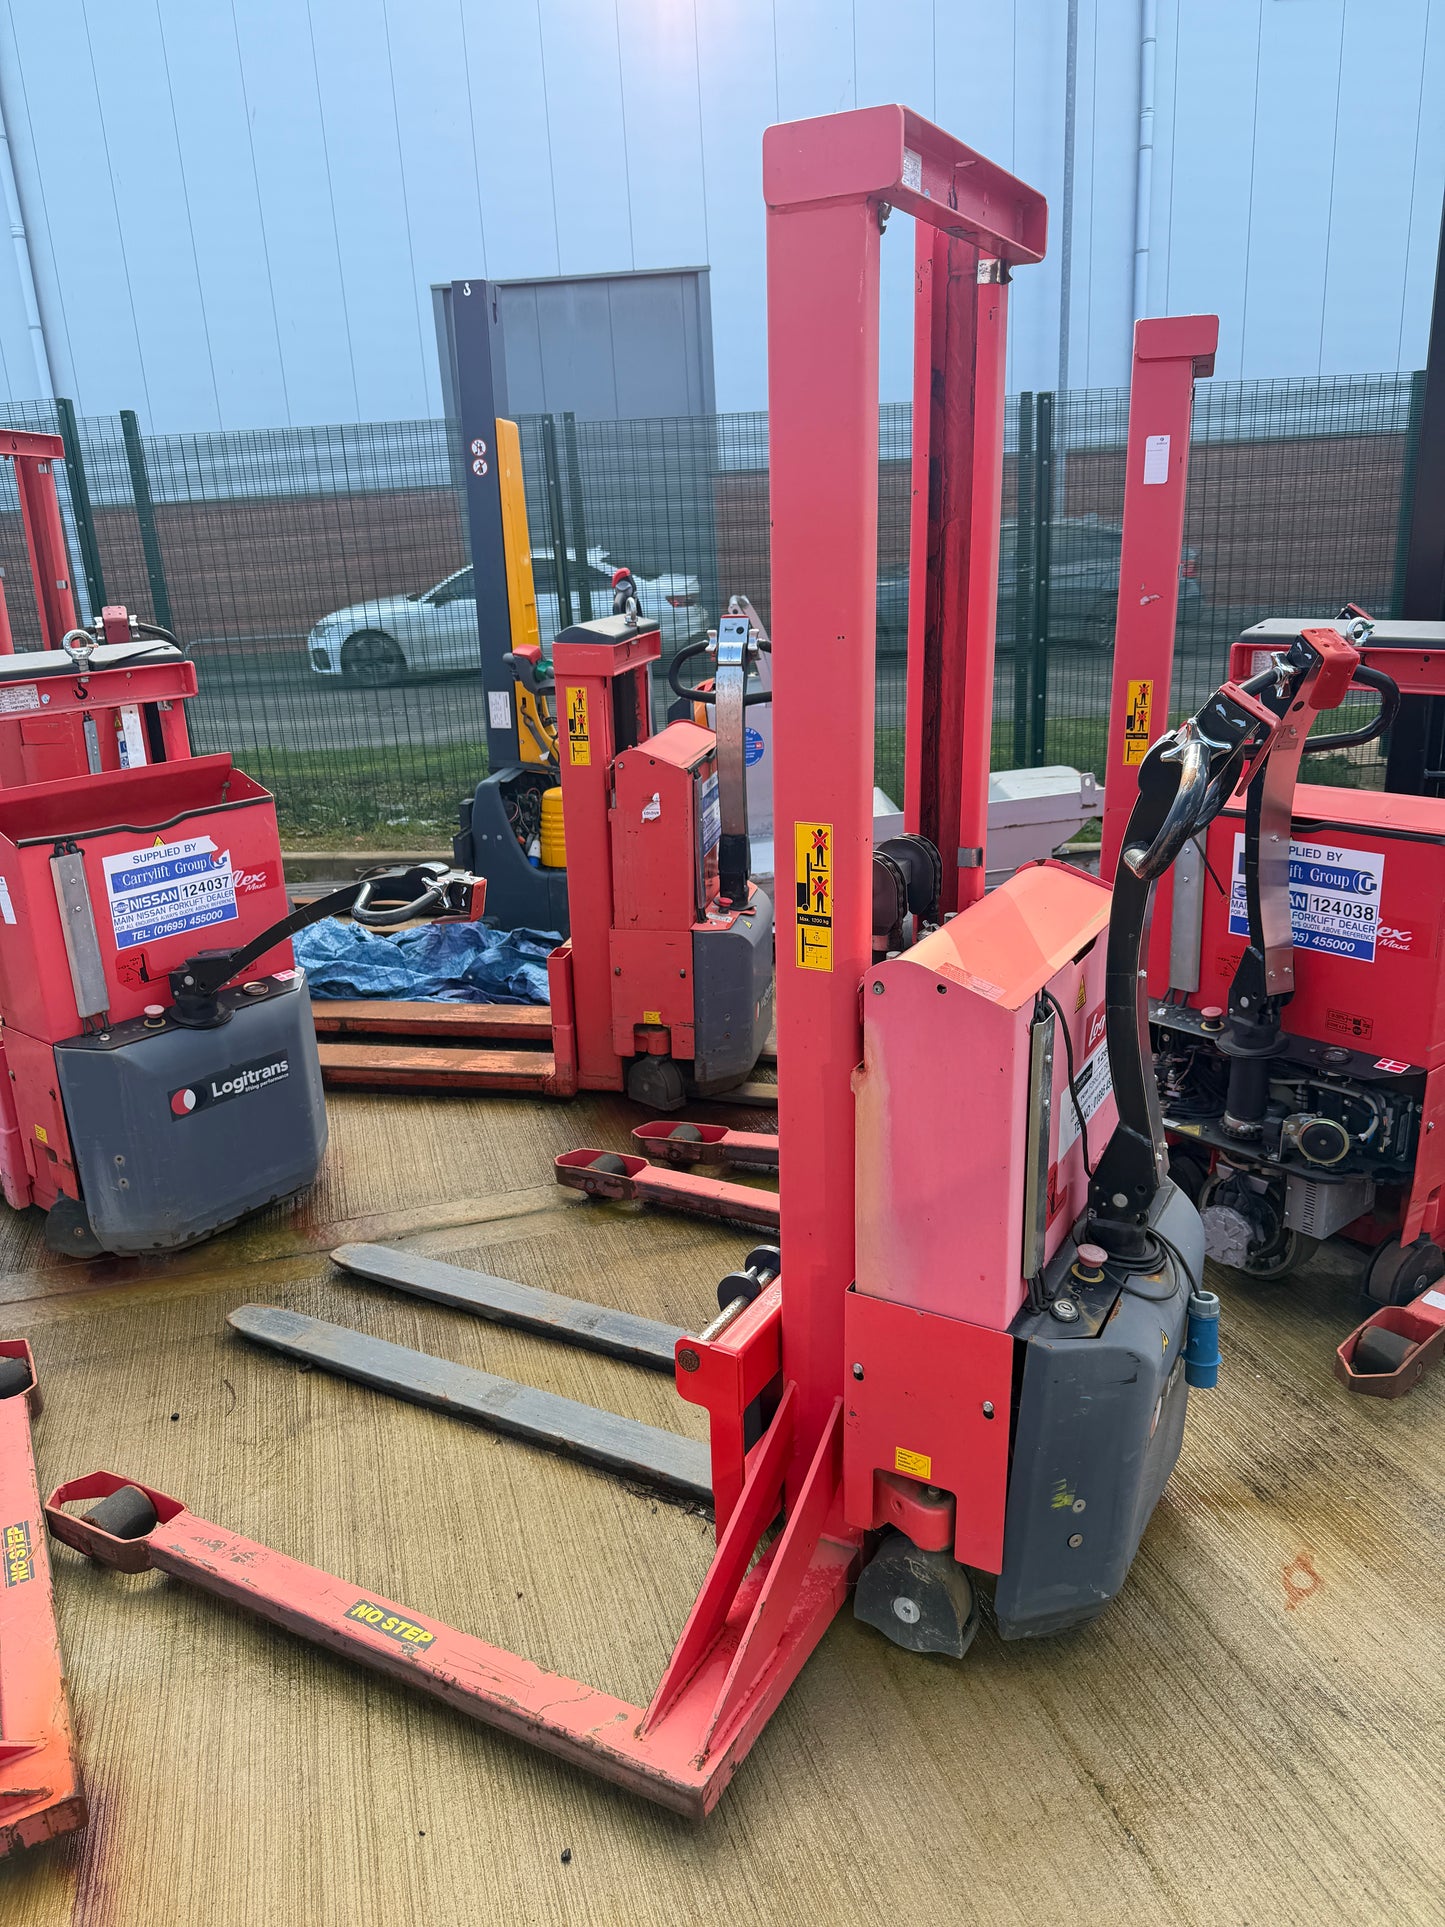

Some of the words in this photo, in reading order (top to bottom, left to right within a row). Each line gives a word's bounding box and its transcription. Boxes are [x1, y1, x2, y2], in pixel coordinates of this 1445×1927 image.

[133, 846, 180, 864] SUPPLIED
[184, 843, 196, 852] BY
[1327, 852, 1343, 862] BY
[122, 865, 170, 887] Carrylift
[175, 858, 207, 874] Group
[1310, 868, 1350, 888] Group
[129, 889, 178, 910] NISSAN
[182, 876, 230, 898] 124037
[114, 914, 134, 926] MAIN
[137, 907, 166, 921] NISSAN
[169, 898, 204, 912] FORKLIFT
[206, 890, 234, 902] DEALER
[160, 912, 178, 920] ALWAYS
[180, 908, 194, 916] QUOTE
[196, 904, 210, 912] ABOVE
[211, 898, 234, 908] REFERENCE
[1312, 898, 1374, 921] 124038
[132, 930, 150, 941] TEL:
[154, 917, 186, 936] (01695)
[190, 910, 223, 926] 455000
[1292, 911, 1335, 926] FORKLIFT
[1338, 920, 1376, 934] DEALER
[1303, 923, 1320, 931] QUOTE
[1322, 926, 1342, 935] ABOVE
[1342, 930, 1375, 942] REFERENCE
[1312, 936, 1356, 952] 455000
[212, 1060, 289, 1098] Logitrans
[245, 1082, 260, 1092] lifting
[260, 1072, 289, 1088] performance
[7, 1526, 26, 1560] STEP
[10, 1560, 28, 1582] NO
[350, 1604, 384, 1623] NO
[381, 1617, 434, 1643] STEP
